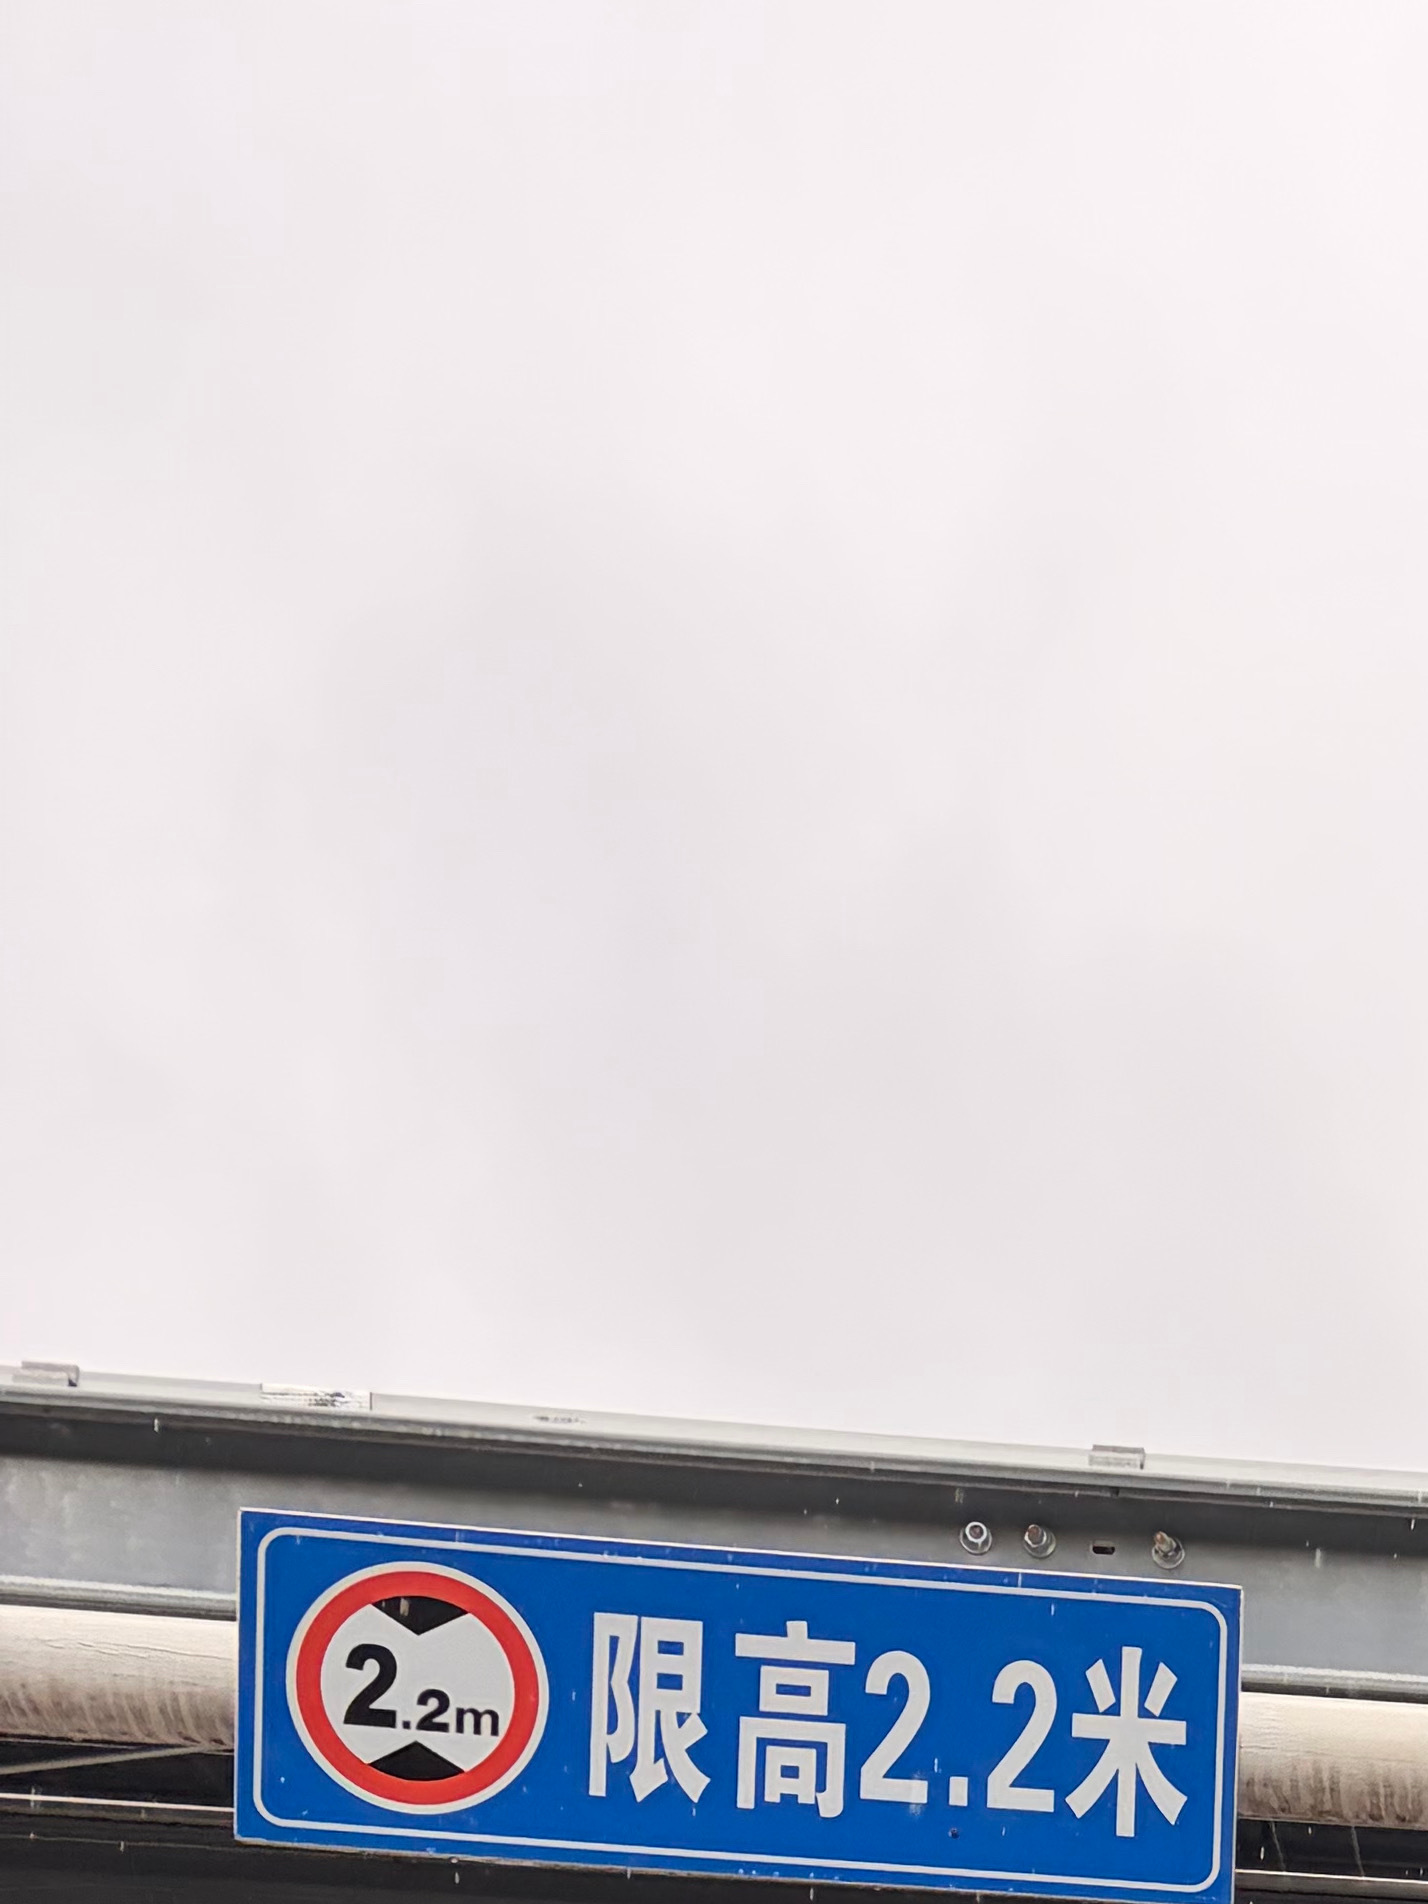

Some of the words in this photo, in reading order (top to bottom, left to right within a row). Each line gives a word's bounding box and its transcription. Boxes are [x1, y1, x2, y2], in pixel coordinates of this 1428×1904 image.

[343, 1642, 501, 1739] 2.2m
[588, 1611, 1188, 1838] 限高2.2米
